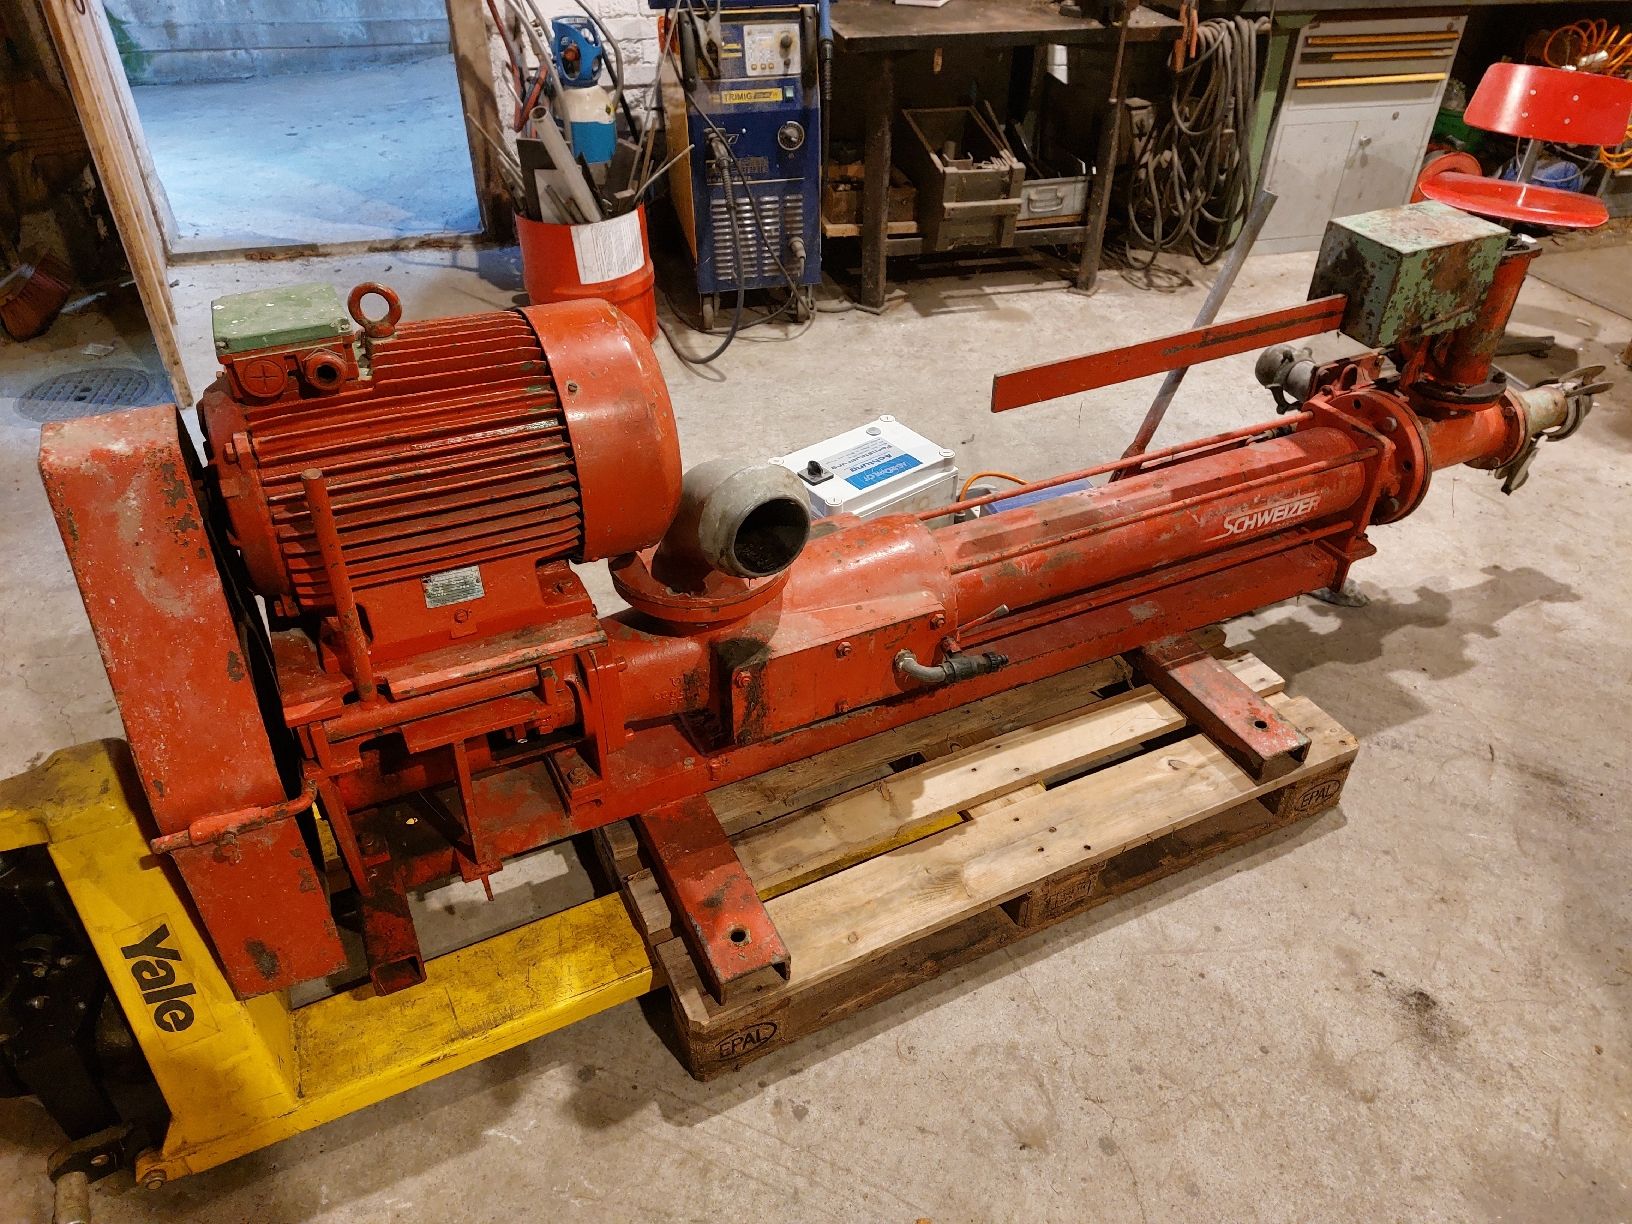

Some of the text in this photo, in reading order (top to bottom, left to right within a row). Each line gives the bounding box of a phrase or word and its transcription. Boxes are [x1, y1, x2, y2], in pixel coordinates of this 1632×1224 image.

[723, 91, 753, 102] TRIMIG
[1218, 494, 1320, 537] SCHWEIZER
[1301, 784, 1332, 808] EPAL
[120, 923, 197, 1033] Yale
[719, 1028, 768, 1059] EPAL
